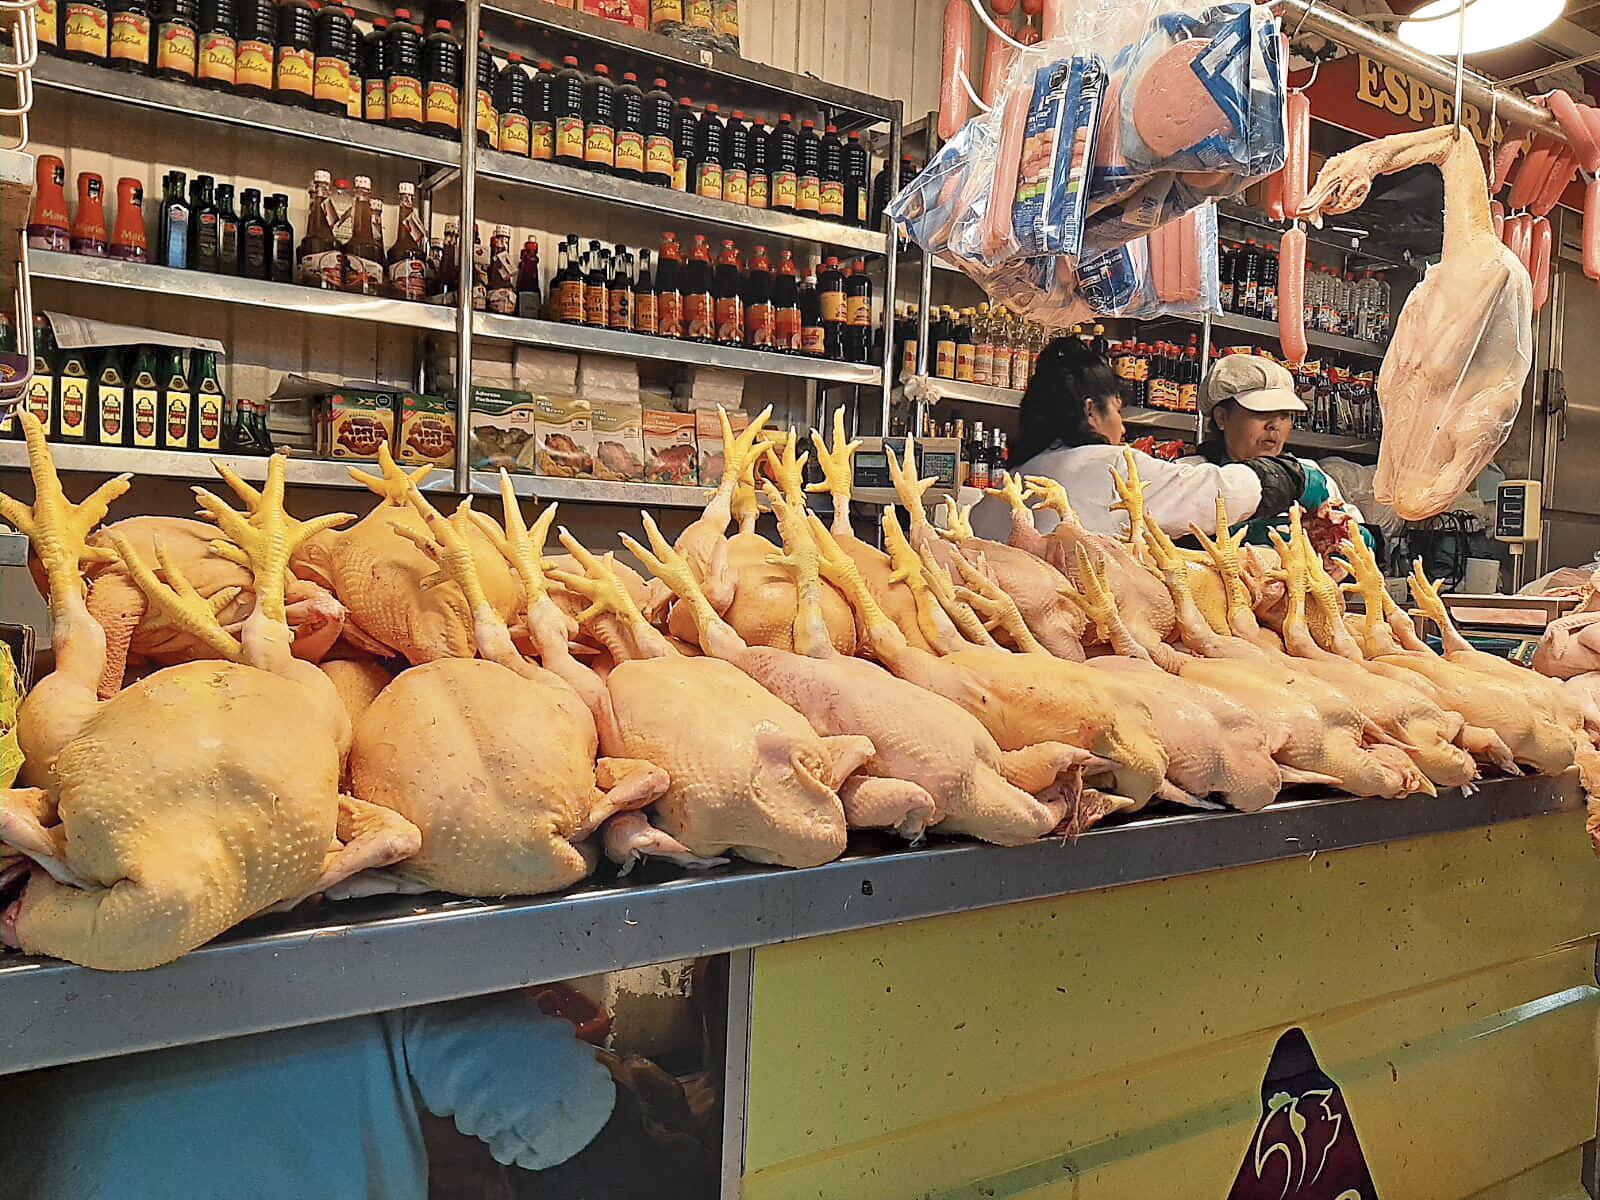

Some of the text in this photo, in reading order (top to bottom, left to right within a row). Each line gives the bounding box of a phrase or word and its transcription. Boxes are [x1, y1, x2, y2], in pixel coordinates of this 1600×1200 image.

[66, 23, 102, 40] Delicia
[238, 59, 268, 73] Delicia
[279, 65, 310, 80] Delicia
[315, 75, 345, 89] Delicia
[391, 94, 420, 108] Delicia
[428, 99, 456, 114] Delicia
[587, 140, 612, 153] Delicia
[617, 146, 641, 161] Delicia
